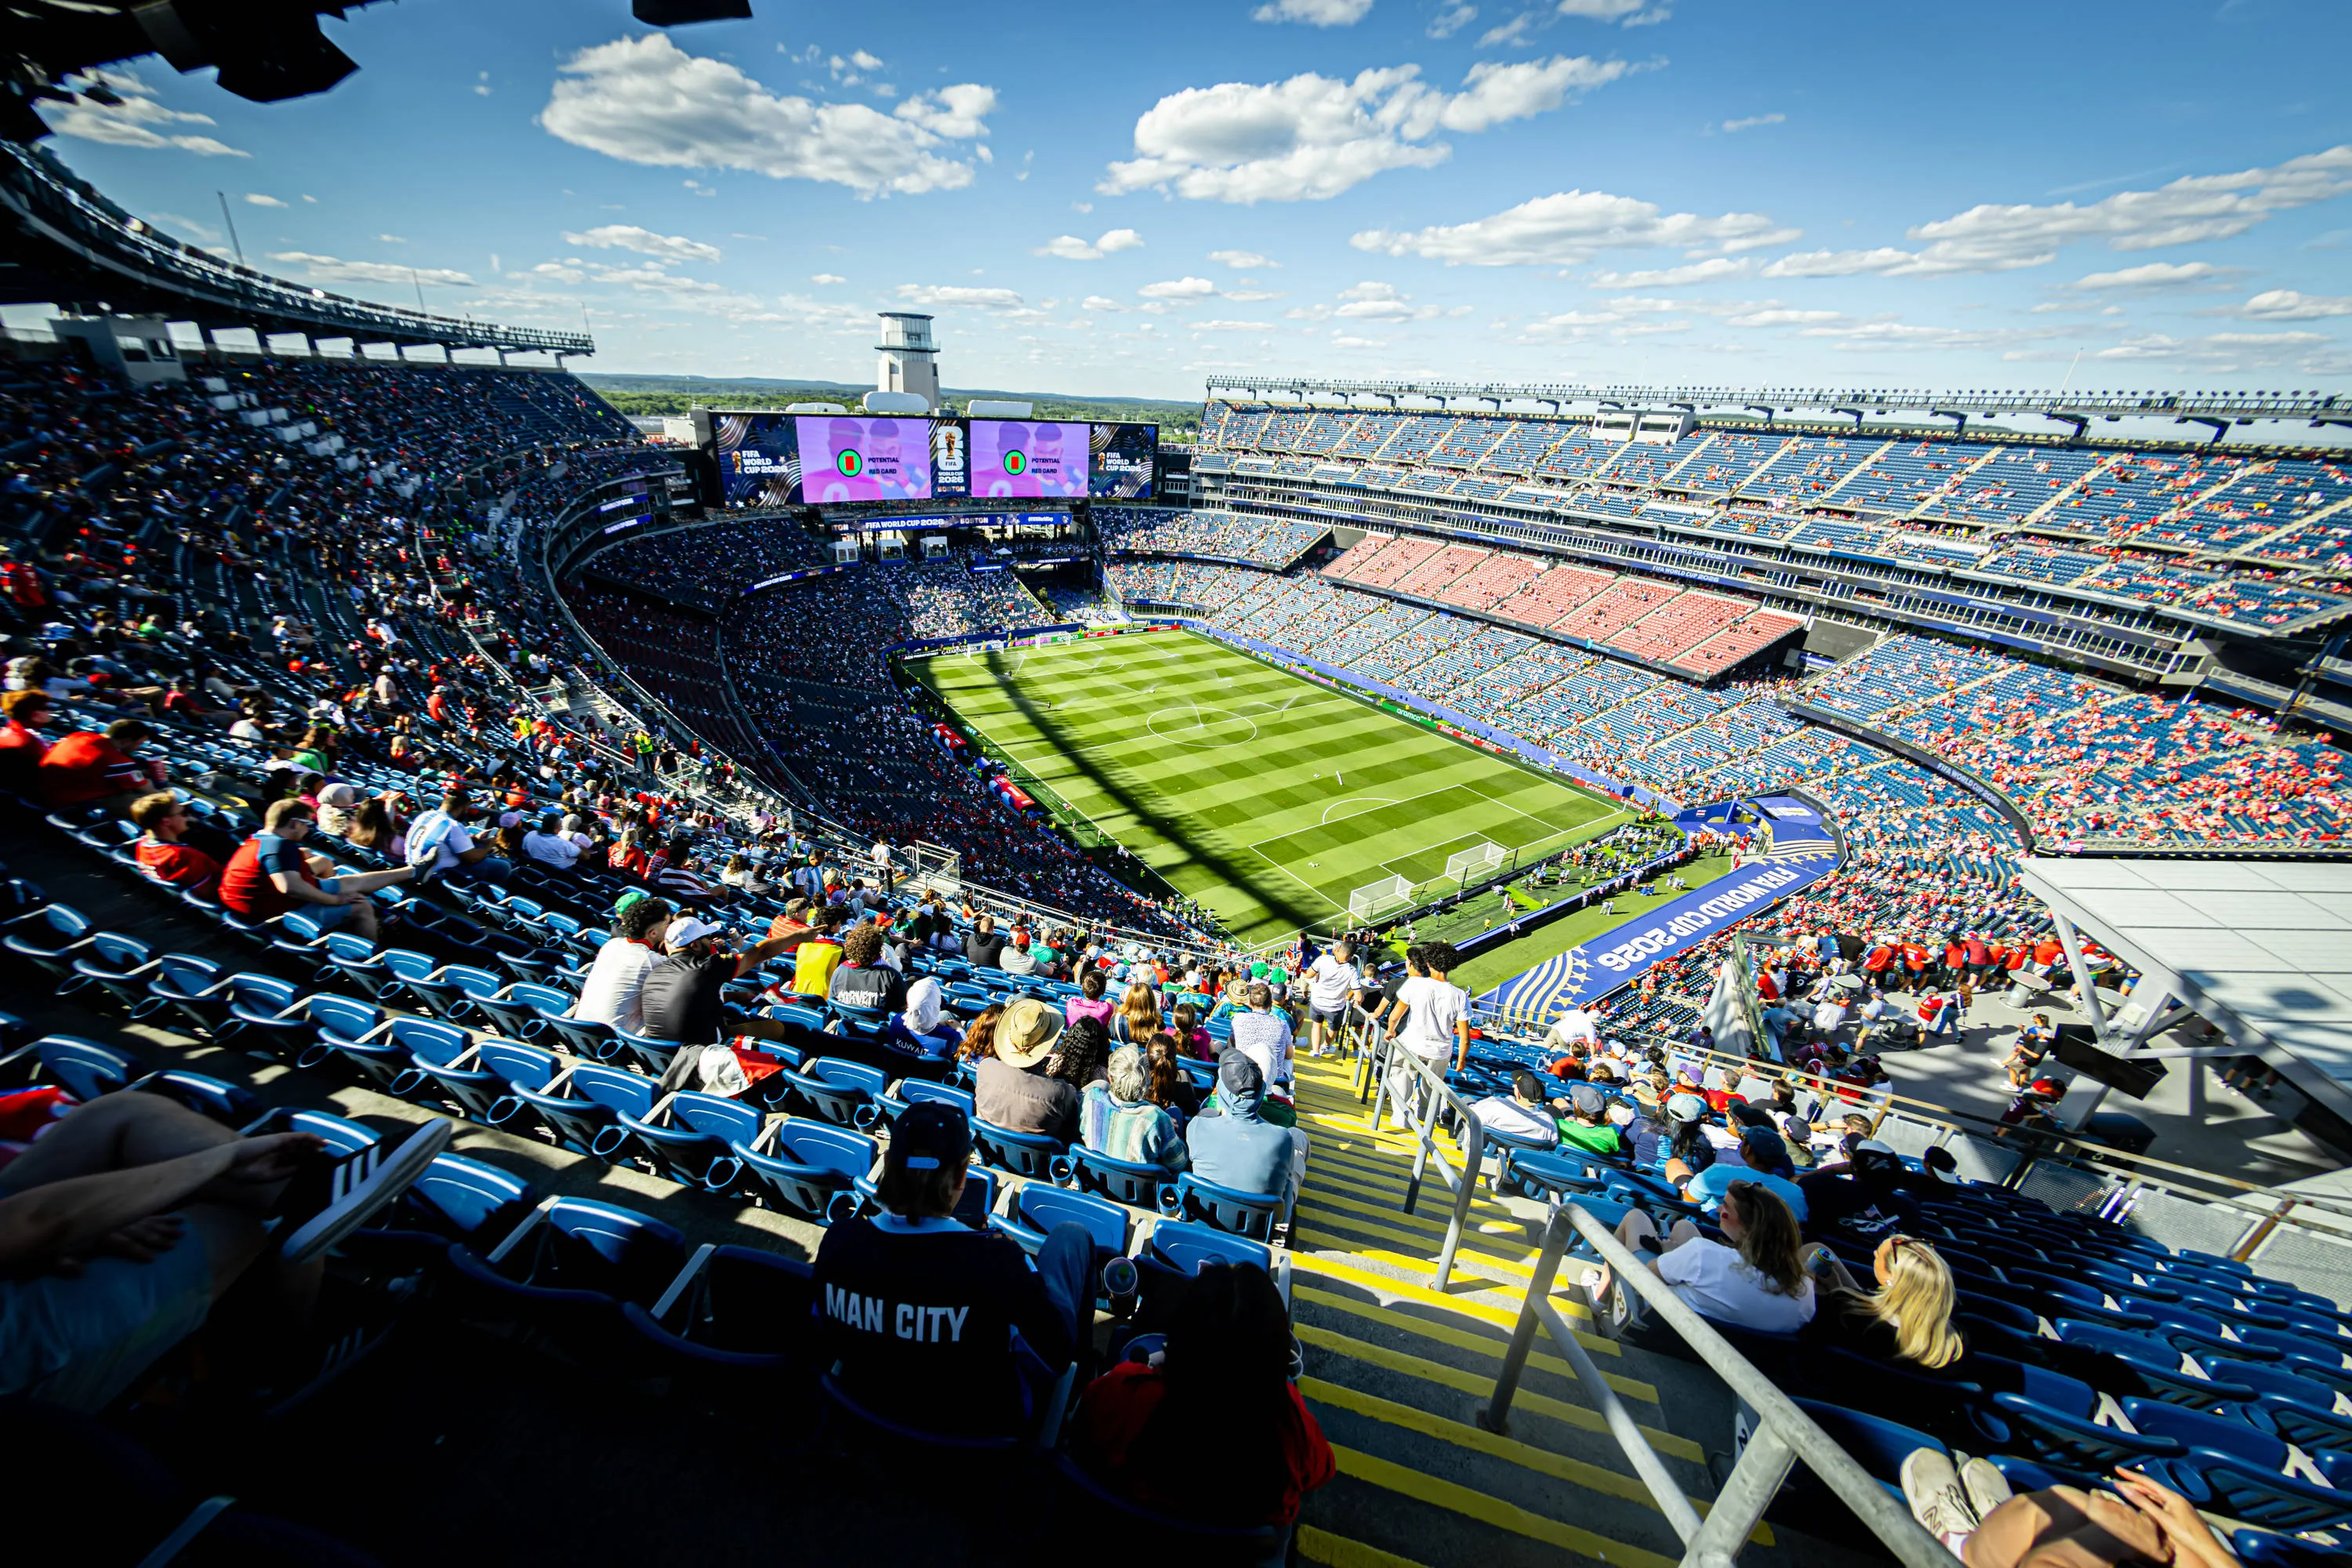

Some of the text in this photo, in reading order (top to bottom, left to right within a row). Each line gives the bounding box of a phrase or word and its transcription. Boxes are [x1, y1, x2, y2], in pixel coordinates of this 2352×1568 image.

[866, 521, 881, 529] FIFA
[1671, 546, 1693, 555] WORLD
[1705, 552, 1727, 561] 2026
[1664, 568, 1686, 576] WORLD
[1697, 574, 1719, 583] 2026
[1396, 708, 1421, 722] aramco
[1530, 760, 1553, 775] HYUNDAI
[1584, 782, 1610, 797] Lenovo
[1621, 796, 1646, 811] Lenovo
[1936, 762, 2001, 807] FIFA WORLD CUP 2026
[1597, 866, 1801, 971] FIFA WORLD CUP 2026
[1796, 978, 1805, 987] 9
[896, 1038, 929, 1055] KUWAIT
[826, 1283, 970, 1343] MAN CITY
[1737, 1428, 1748, 1452] 2
